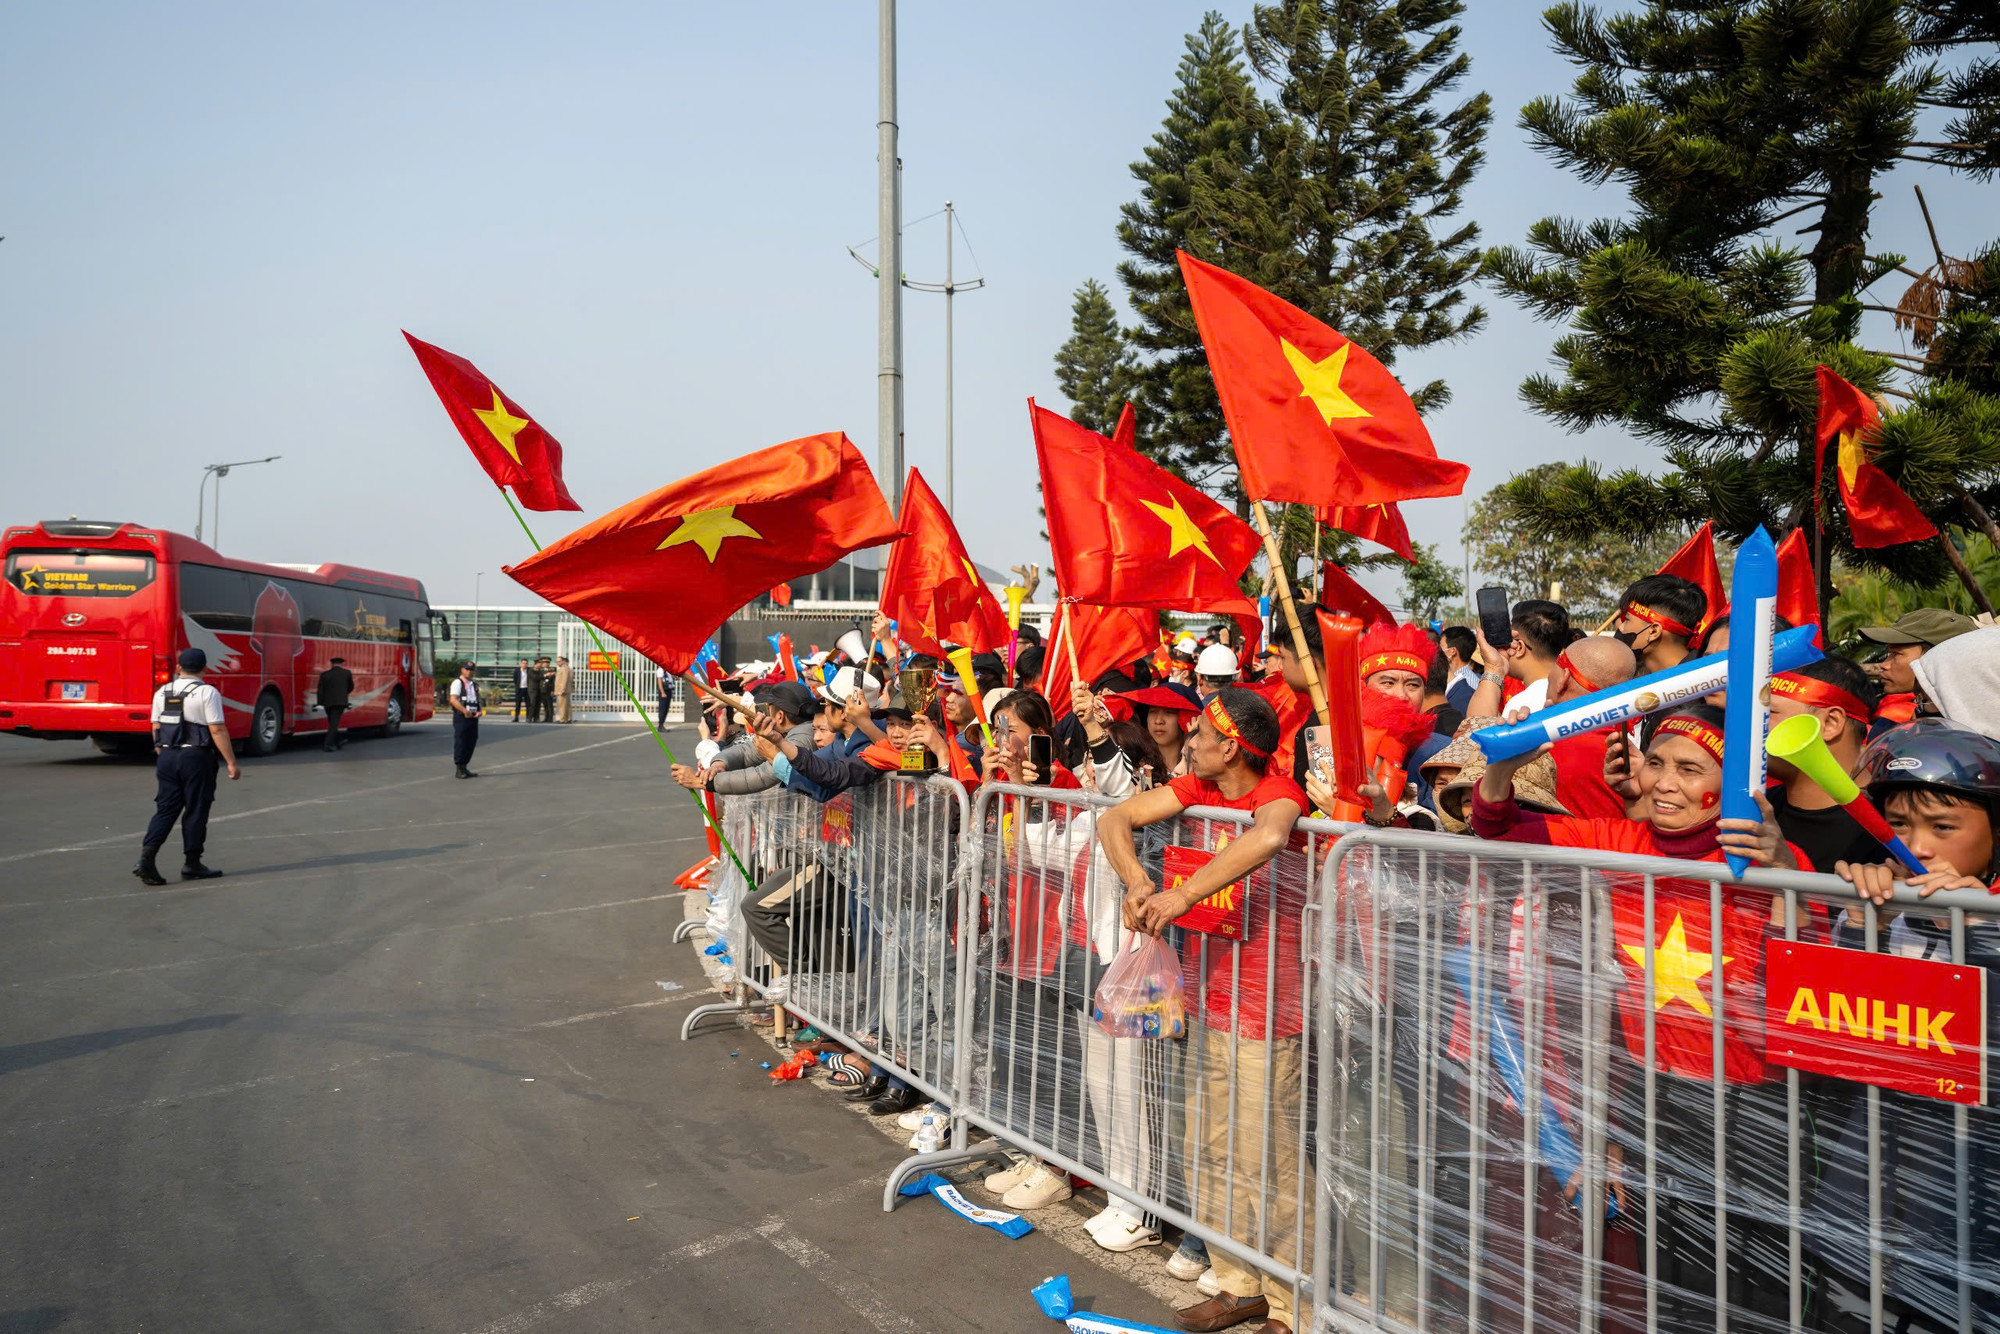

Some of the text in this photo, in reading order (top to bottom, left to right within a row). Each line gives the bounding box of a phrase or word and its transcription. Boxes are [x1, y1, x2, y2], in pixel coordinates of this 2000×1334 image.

[45, 573, 88, 581] VIETNAM
[43, 582, 136, 591] Golden Star Warriors
[1396, 656, 1418, 669] NAM
[1557, 674, 1728, 738] BAOVIET Insuranc
[1784, 986, 1957, 1056] ANHK
[1936, 1077, 1957, 1095] 12
